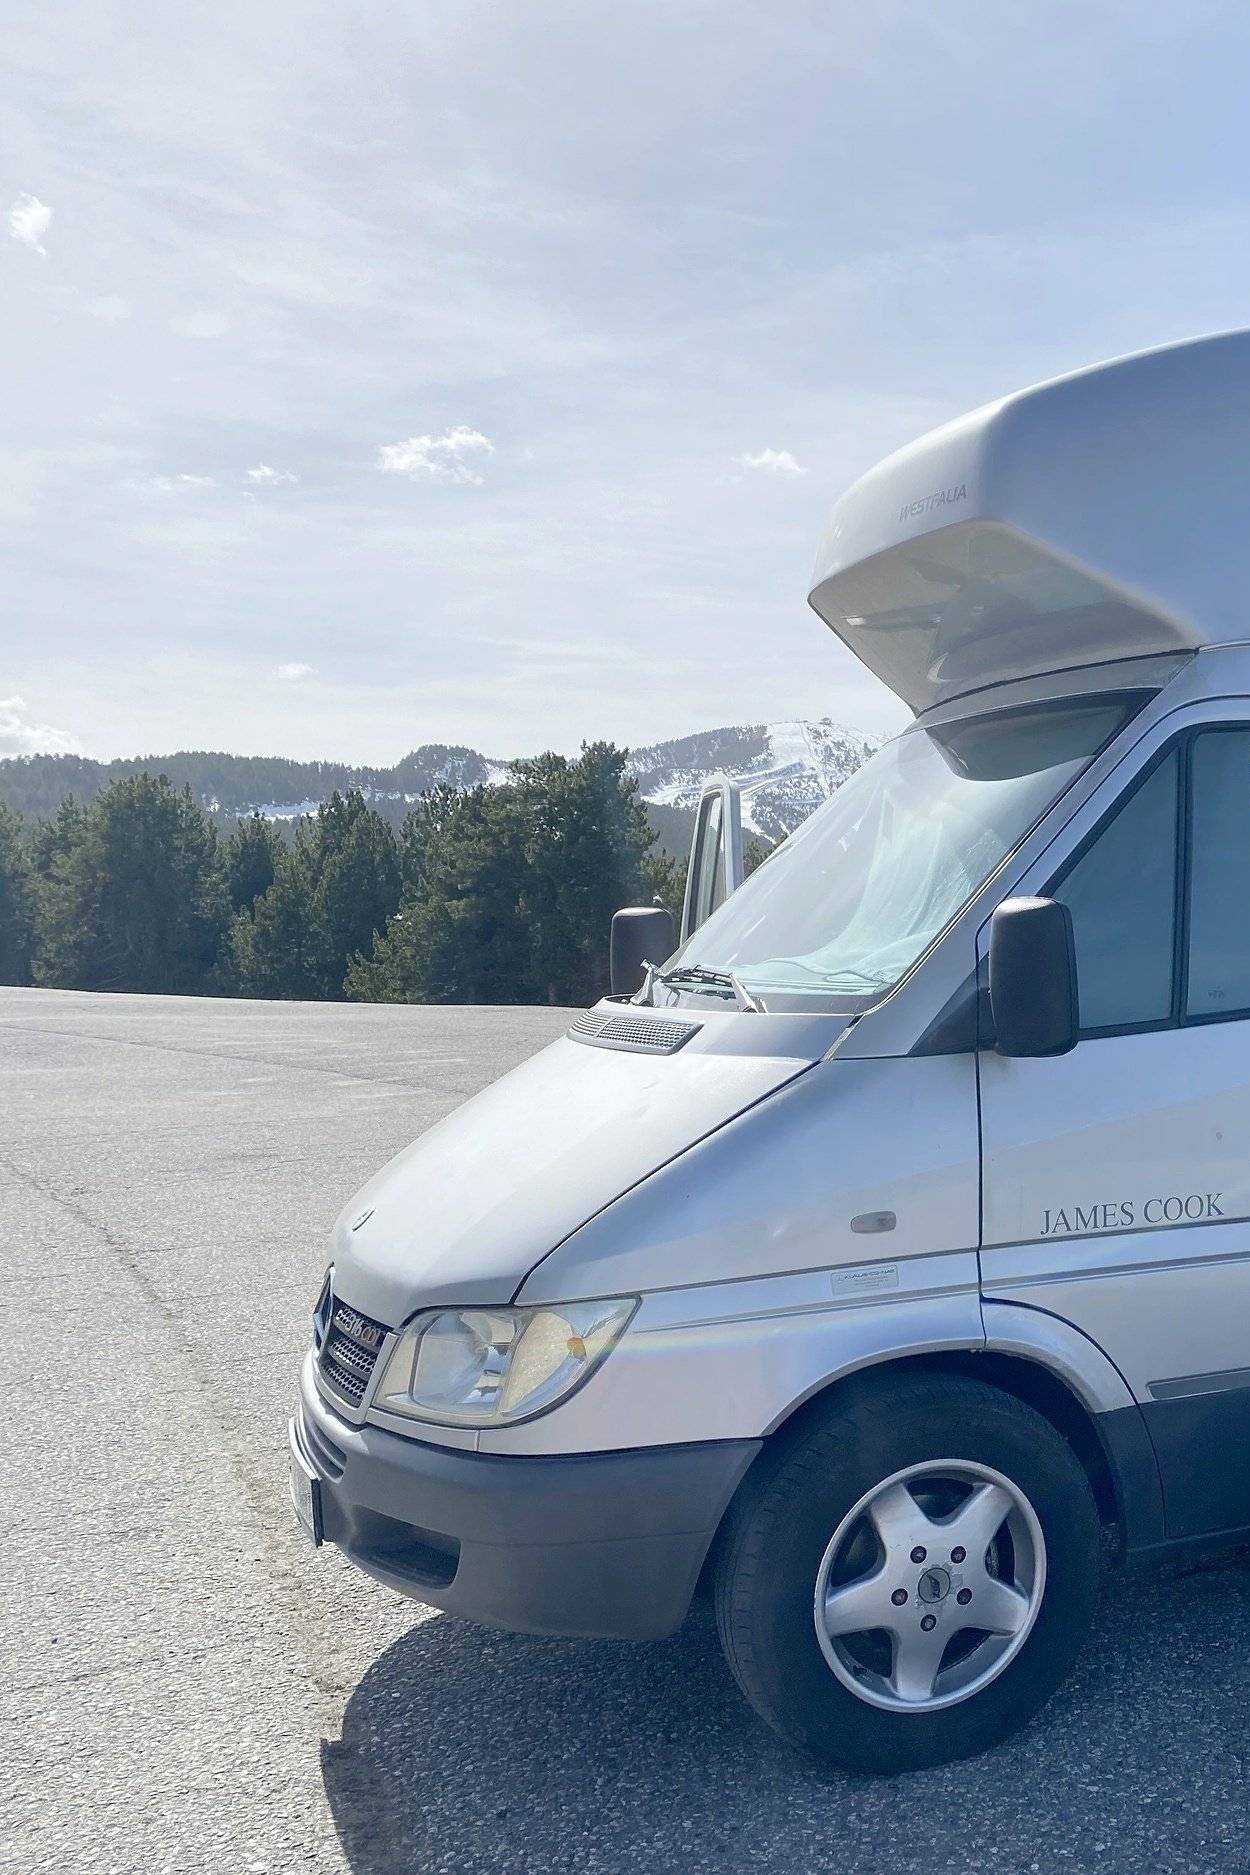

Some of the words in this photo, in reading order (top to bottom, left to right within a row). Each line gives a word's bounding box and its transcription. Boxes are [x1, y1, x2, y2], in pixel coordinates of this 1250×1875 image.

[900, 484, 967, 520] WESTFALIA
[1041, 1201, 1135, 1235] JAMES
[1143, 1193, 1225, 1223] COOK
